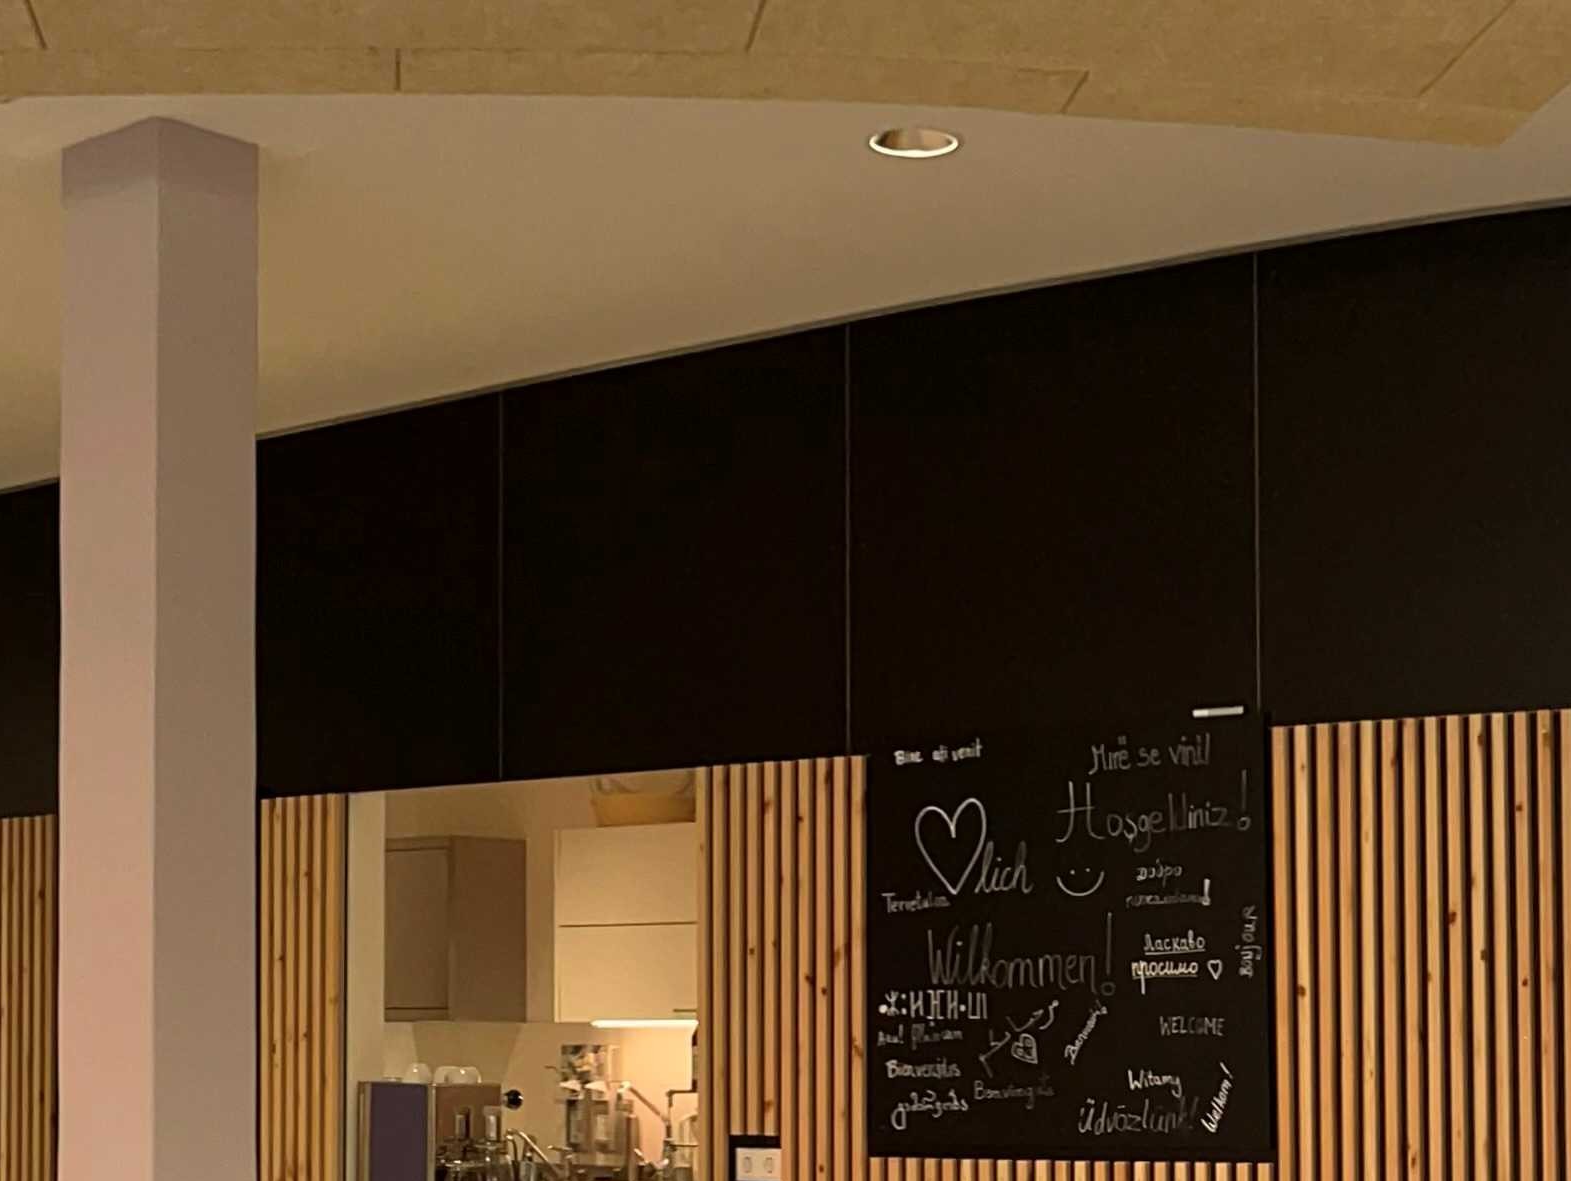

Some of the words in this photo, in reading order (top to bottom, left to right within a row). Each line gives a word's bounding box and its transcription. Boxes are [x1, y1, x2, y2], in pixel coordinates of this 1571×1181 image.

[1136, 746, 1161, 766] se
[1159, 1015, 1225, 1036] WELCOME
[1127, 1069, 1183, 1098] Witamy
